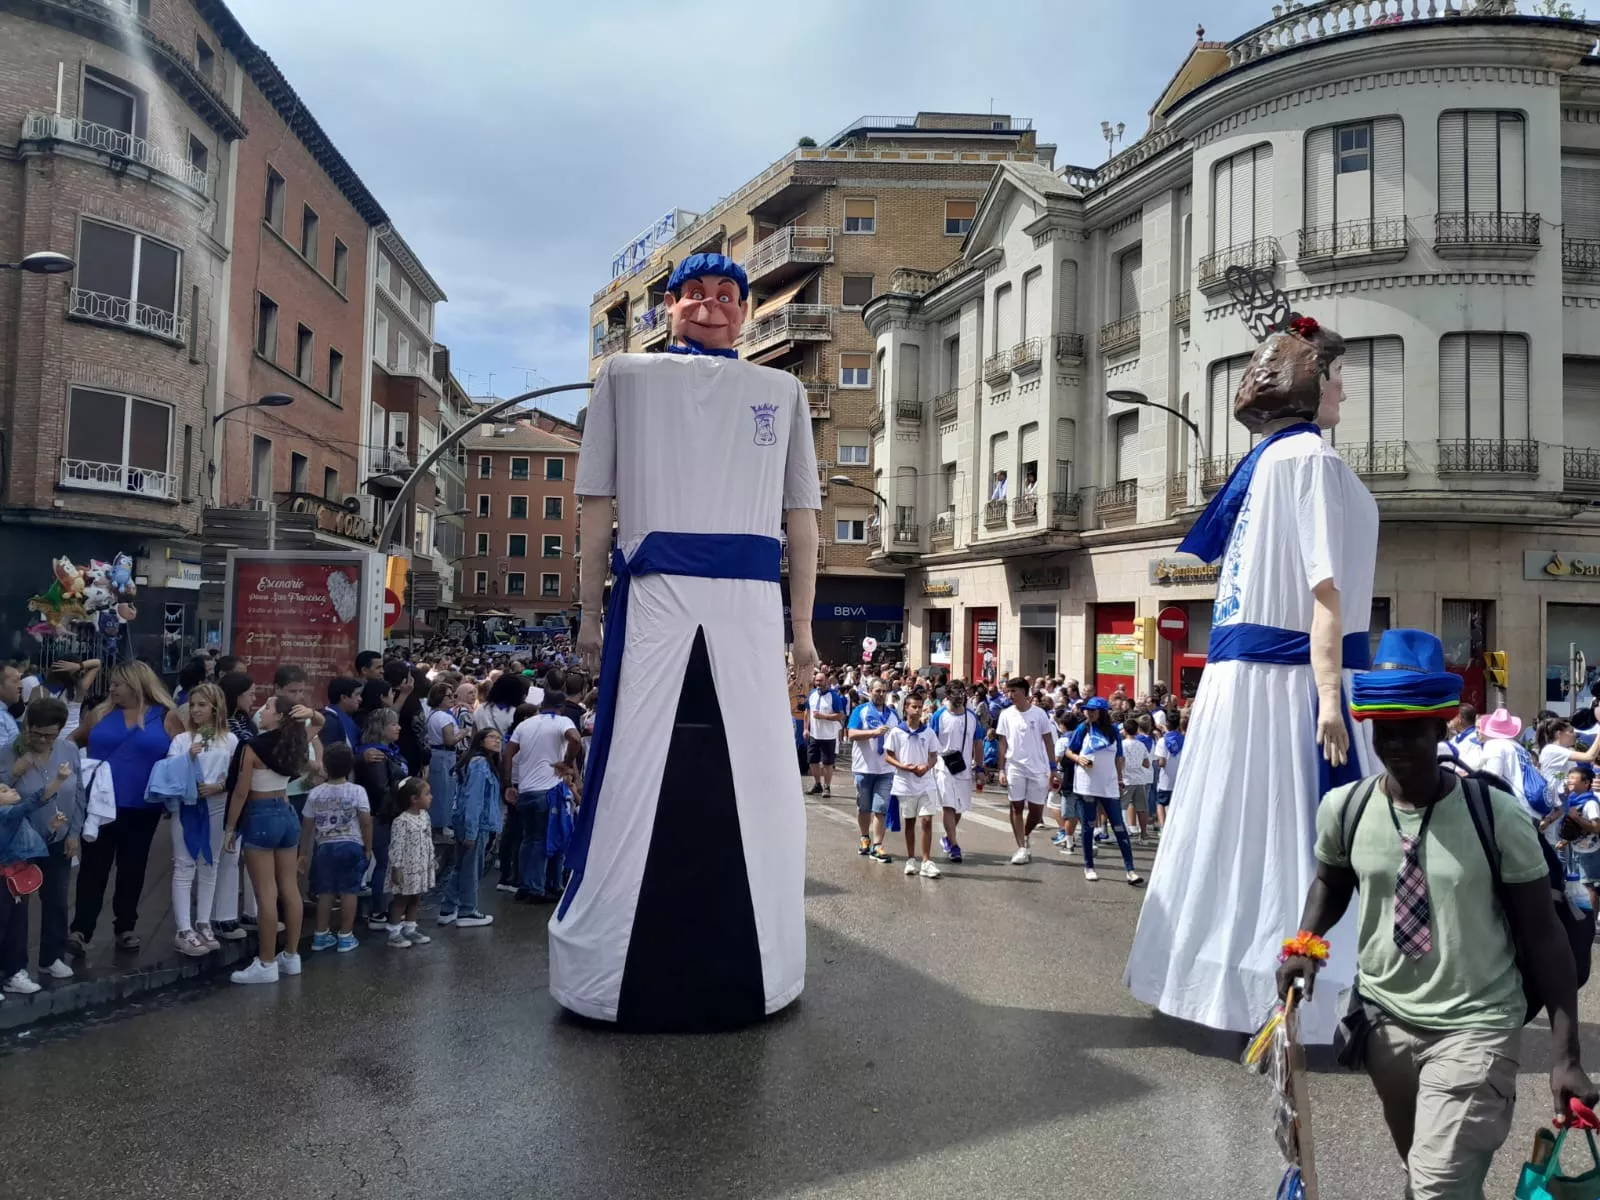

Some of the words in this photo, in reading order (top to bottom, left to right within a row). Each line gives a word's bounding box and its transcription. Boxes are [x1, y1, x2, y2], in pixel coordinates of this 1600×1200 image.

[257, 576, 305, 592] Escenario
[288, 592, 327, 603] Francisco
[834, 606, 866, 616] BBVA
[246, 631, 255, 643] 2
